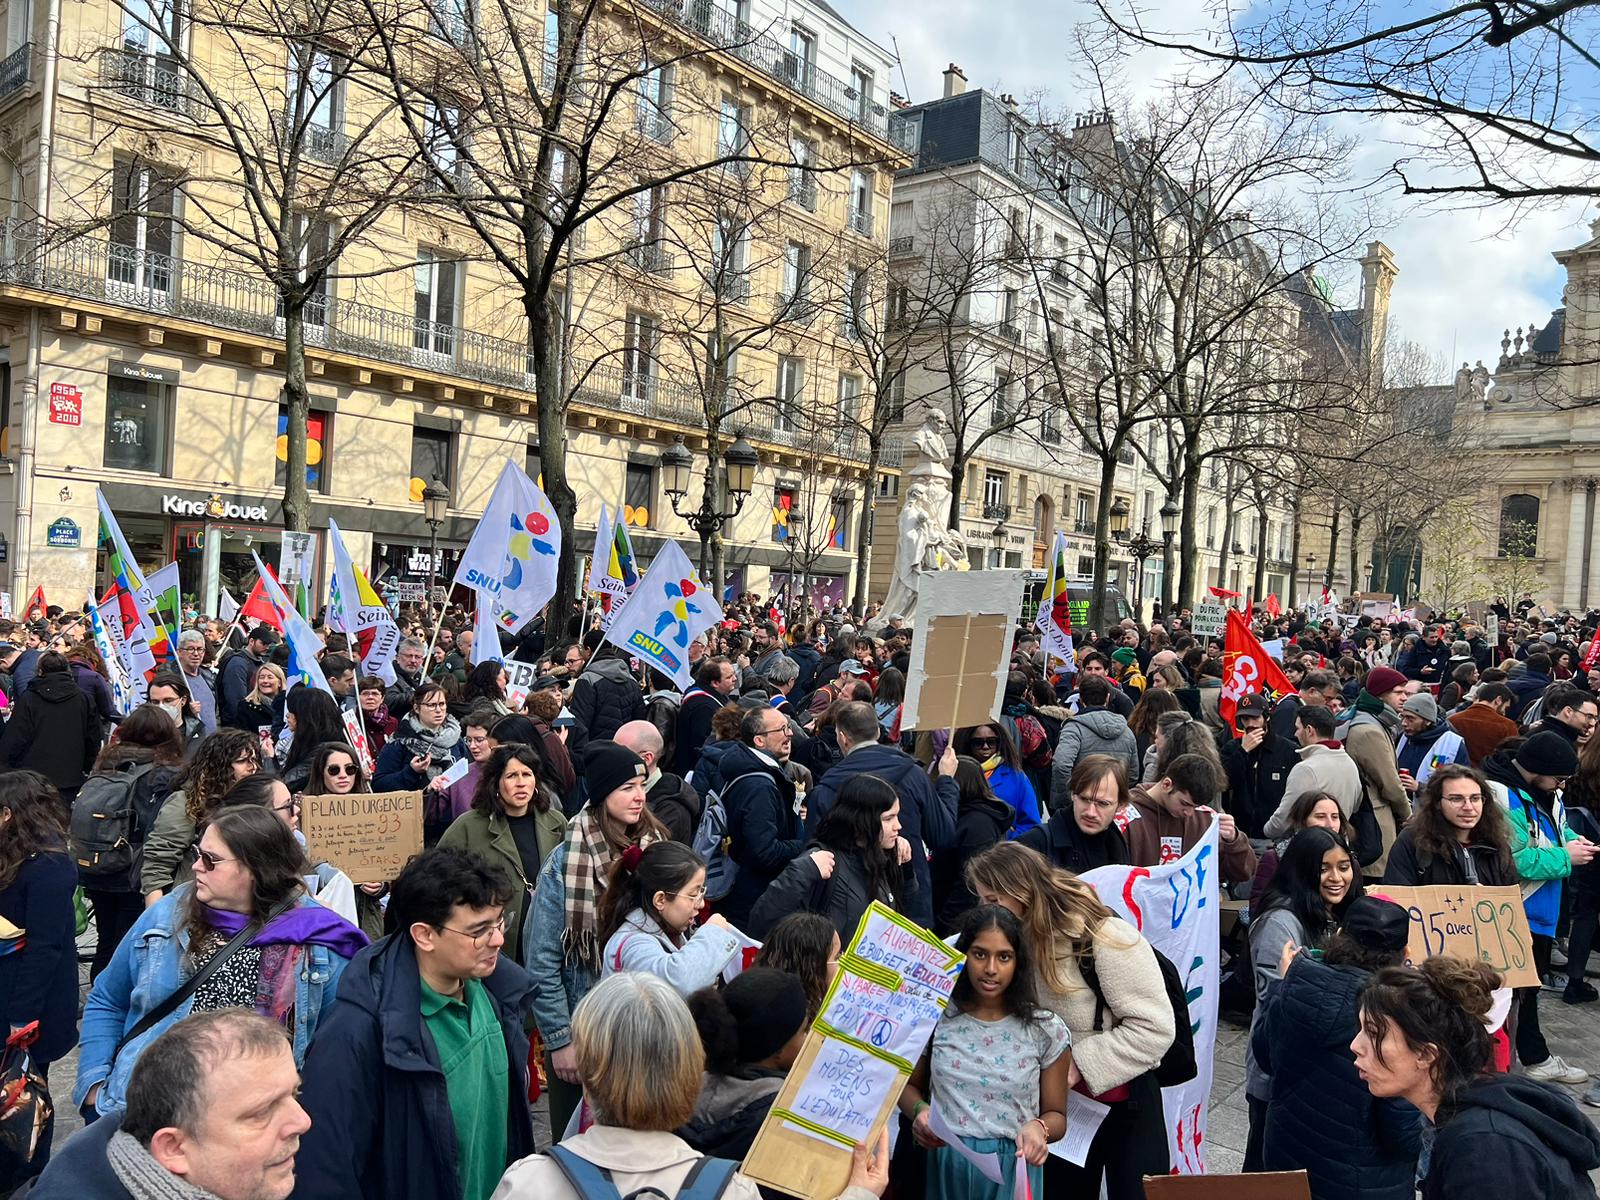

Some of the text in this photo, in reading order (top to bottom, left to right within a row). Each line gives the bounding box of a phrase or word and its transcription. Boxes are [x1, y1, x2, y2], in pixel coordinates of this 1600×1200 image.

[123, 367, 163, 381] King Jouet
[53, 385, 76, 396] 1968
[56, 412, 79, 423] 2018
[162, 494, 268, 521] King Jouet
[966, 529, 1025, 544] LIBRAIRI VRIN
[598, 578, 625, 592] Sein
[357, 608, 391, 627] Sein
[311, 796, 413, 817] PLAN D'URGENCE
[378, 812, 401, 834] 93
[1446, 922, 1473, 936] avec
[865, 942, 908, 972] BUDGET
[879, 924, 948, 969] AUGMENTEZ
[835, 1048, 865, 1073] DES
[818, 1061, 874, 1096] MOYENS
[828, 1084, 855, 1109] POUR
